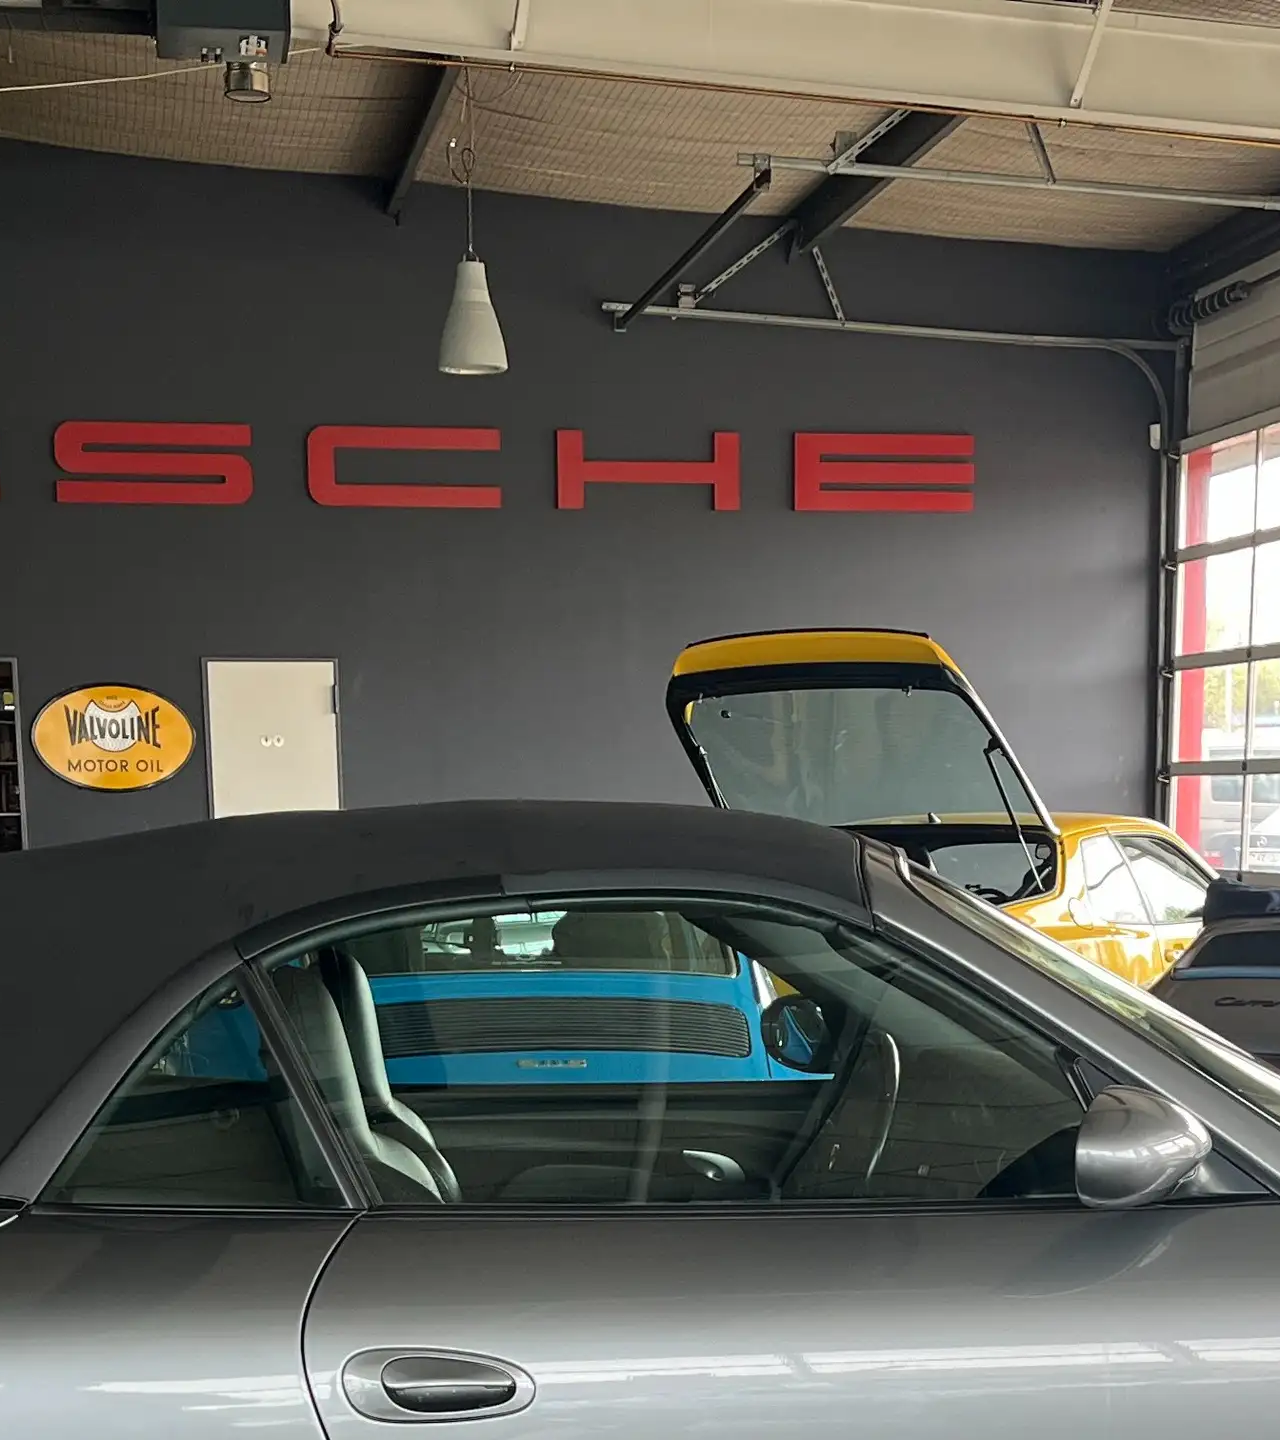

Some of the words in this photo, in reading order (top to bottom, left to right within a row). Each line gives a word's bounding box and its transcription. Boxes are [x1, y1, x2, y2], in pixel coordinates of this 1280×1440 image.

[64, 703, 161, 749] VALVOLINE
[67, 759, 129, 773] MOTOR
[136, 759, 164, 773] OIL
